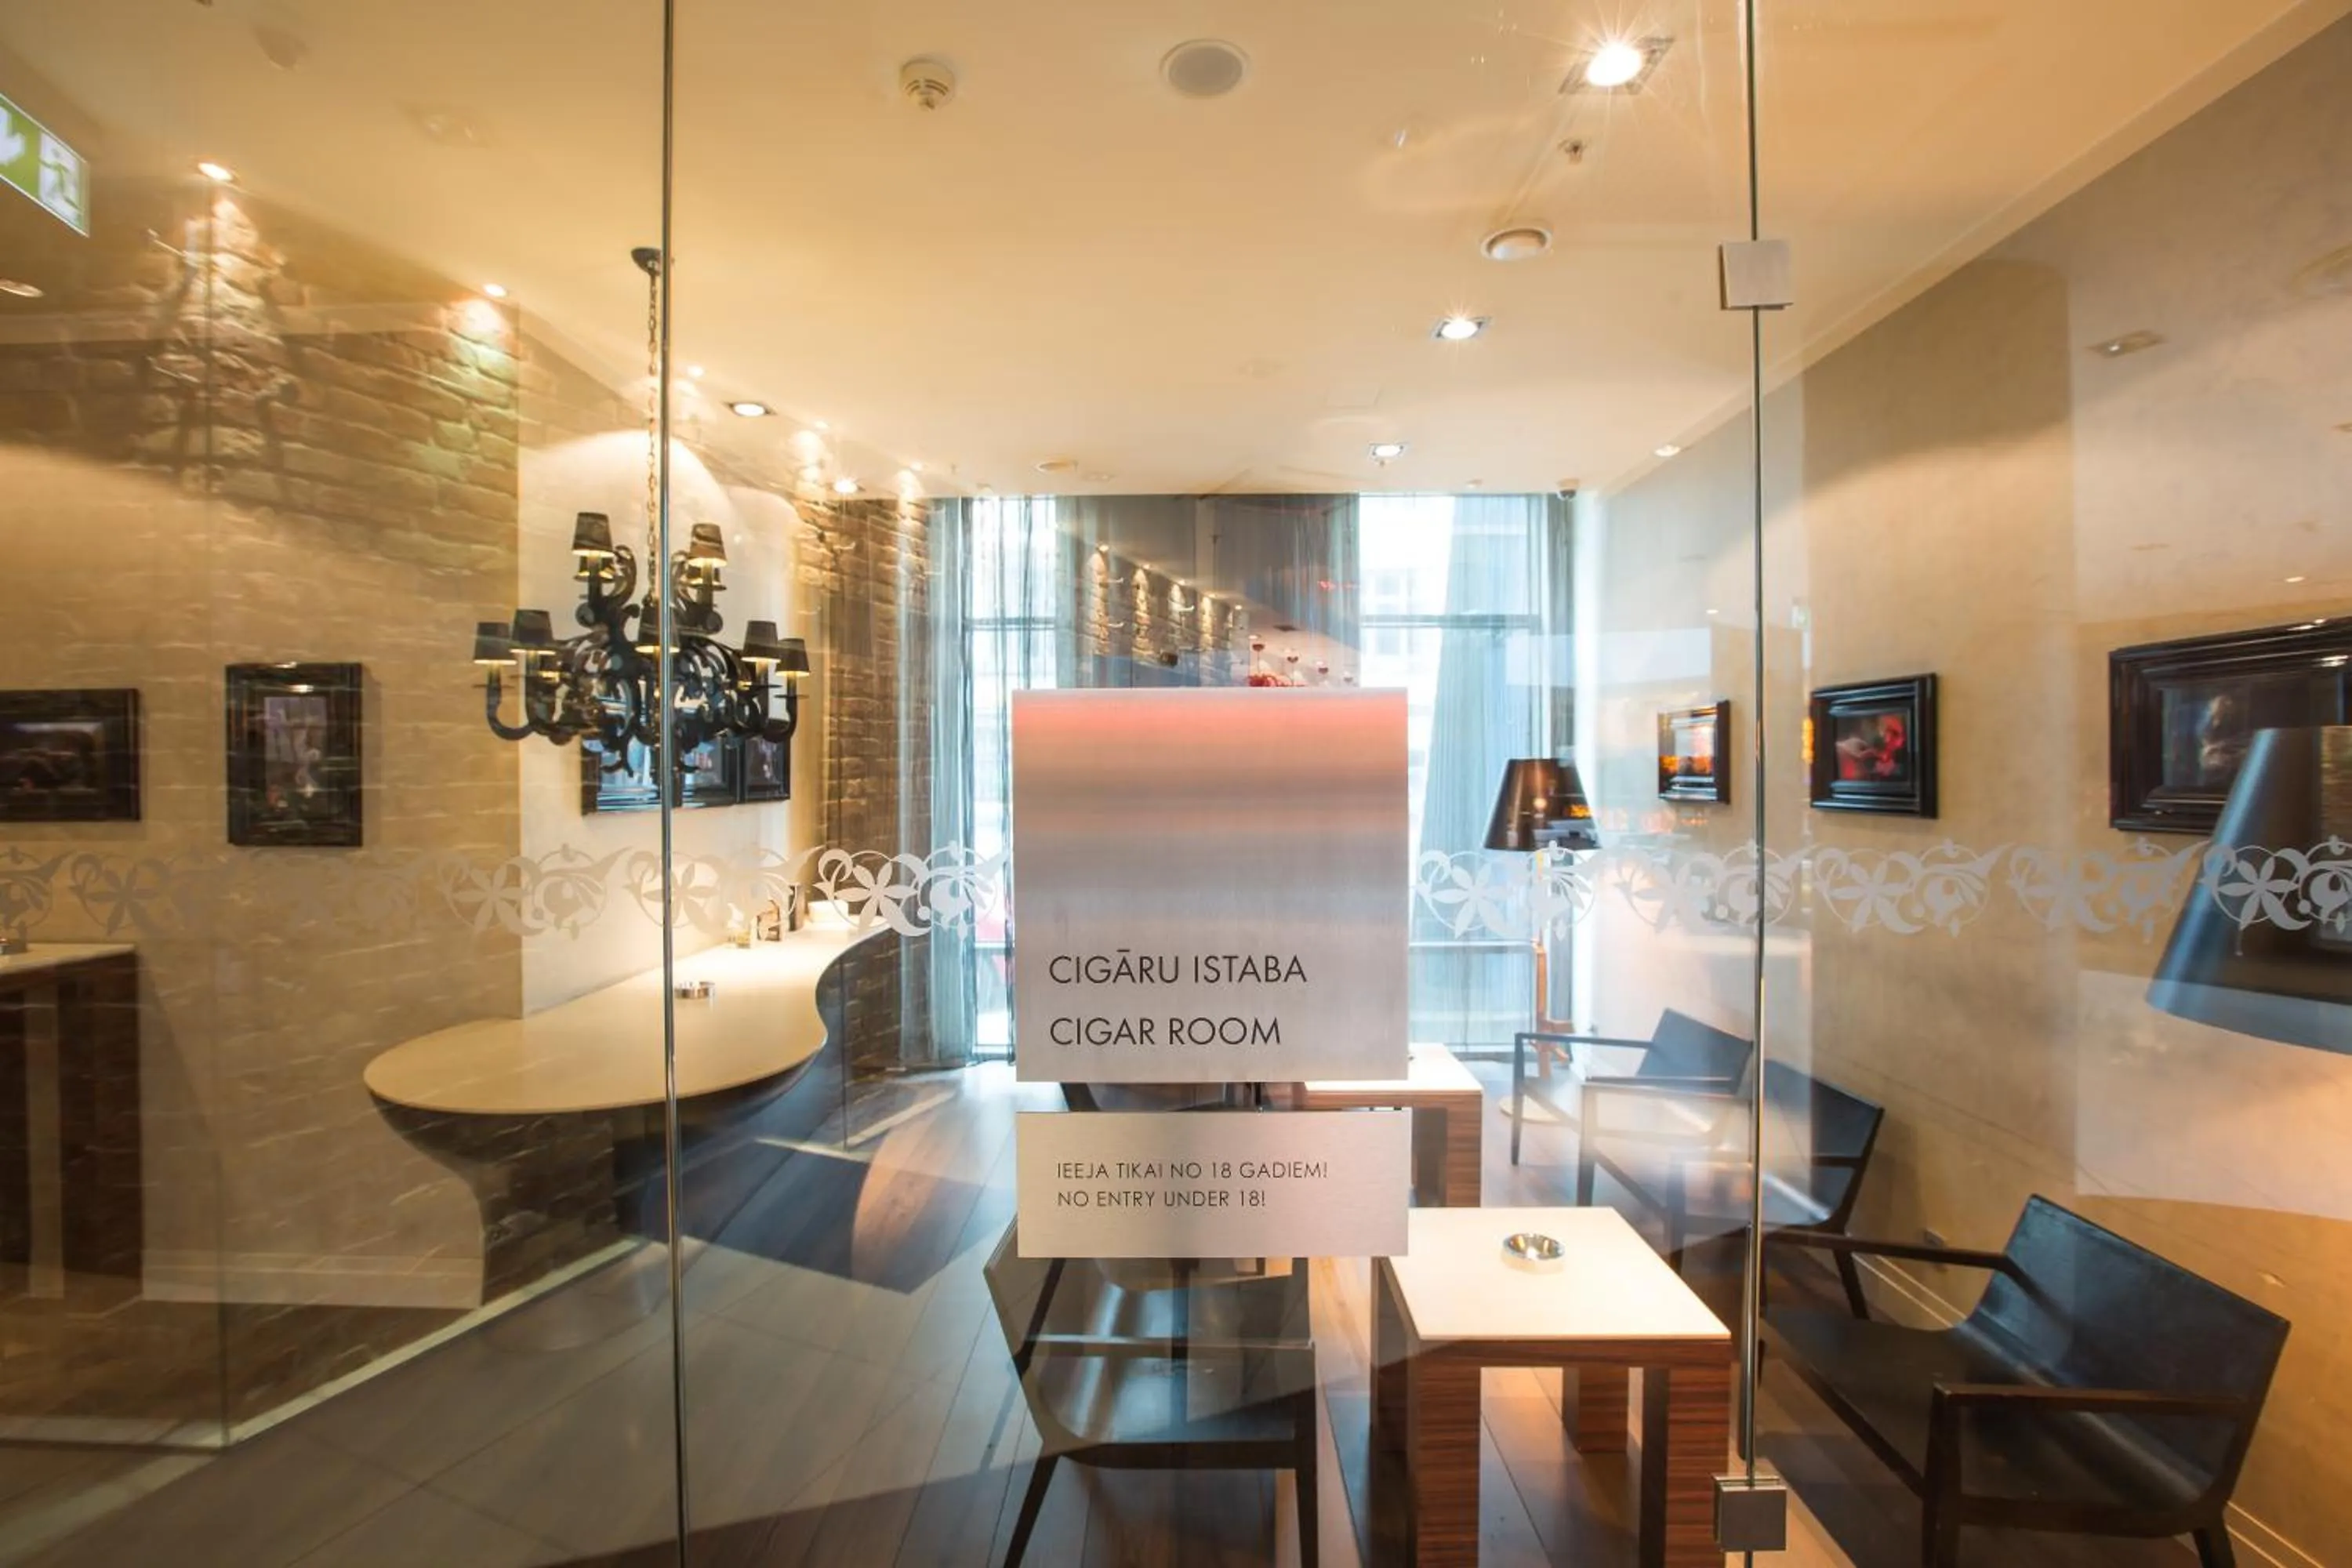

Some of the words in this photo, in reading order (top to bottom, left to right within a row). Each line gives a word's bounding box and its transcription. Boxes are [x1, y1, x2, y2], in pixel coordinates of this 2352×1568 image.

[1049, 949, 1179, 985] CIGĀRU
[1194, 954, 1308, 984] ISTABA
[1050, 1017, 1156, 1046] CIGAR
[1169, 1017, 1281, 1046] ROOM
[1057, 1162, 1109, 1179] IEEJA
[1116, 1162, 1163, 1179] TIKAI
[1171, 1162, 1202, 1179] NO
[1212, 1162, 1232, 1179] 18
[1239, 1161, 1327, 1179] GADIEM!
[1058, 1190, 1089, 1207] NO
[1097, 1190, 1155, 1207] ENTRY
[1164, 1190, 1229, 1207] UNDER
[1240, 1190, 1265, 1207] 18!
